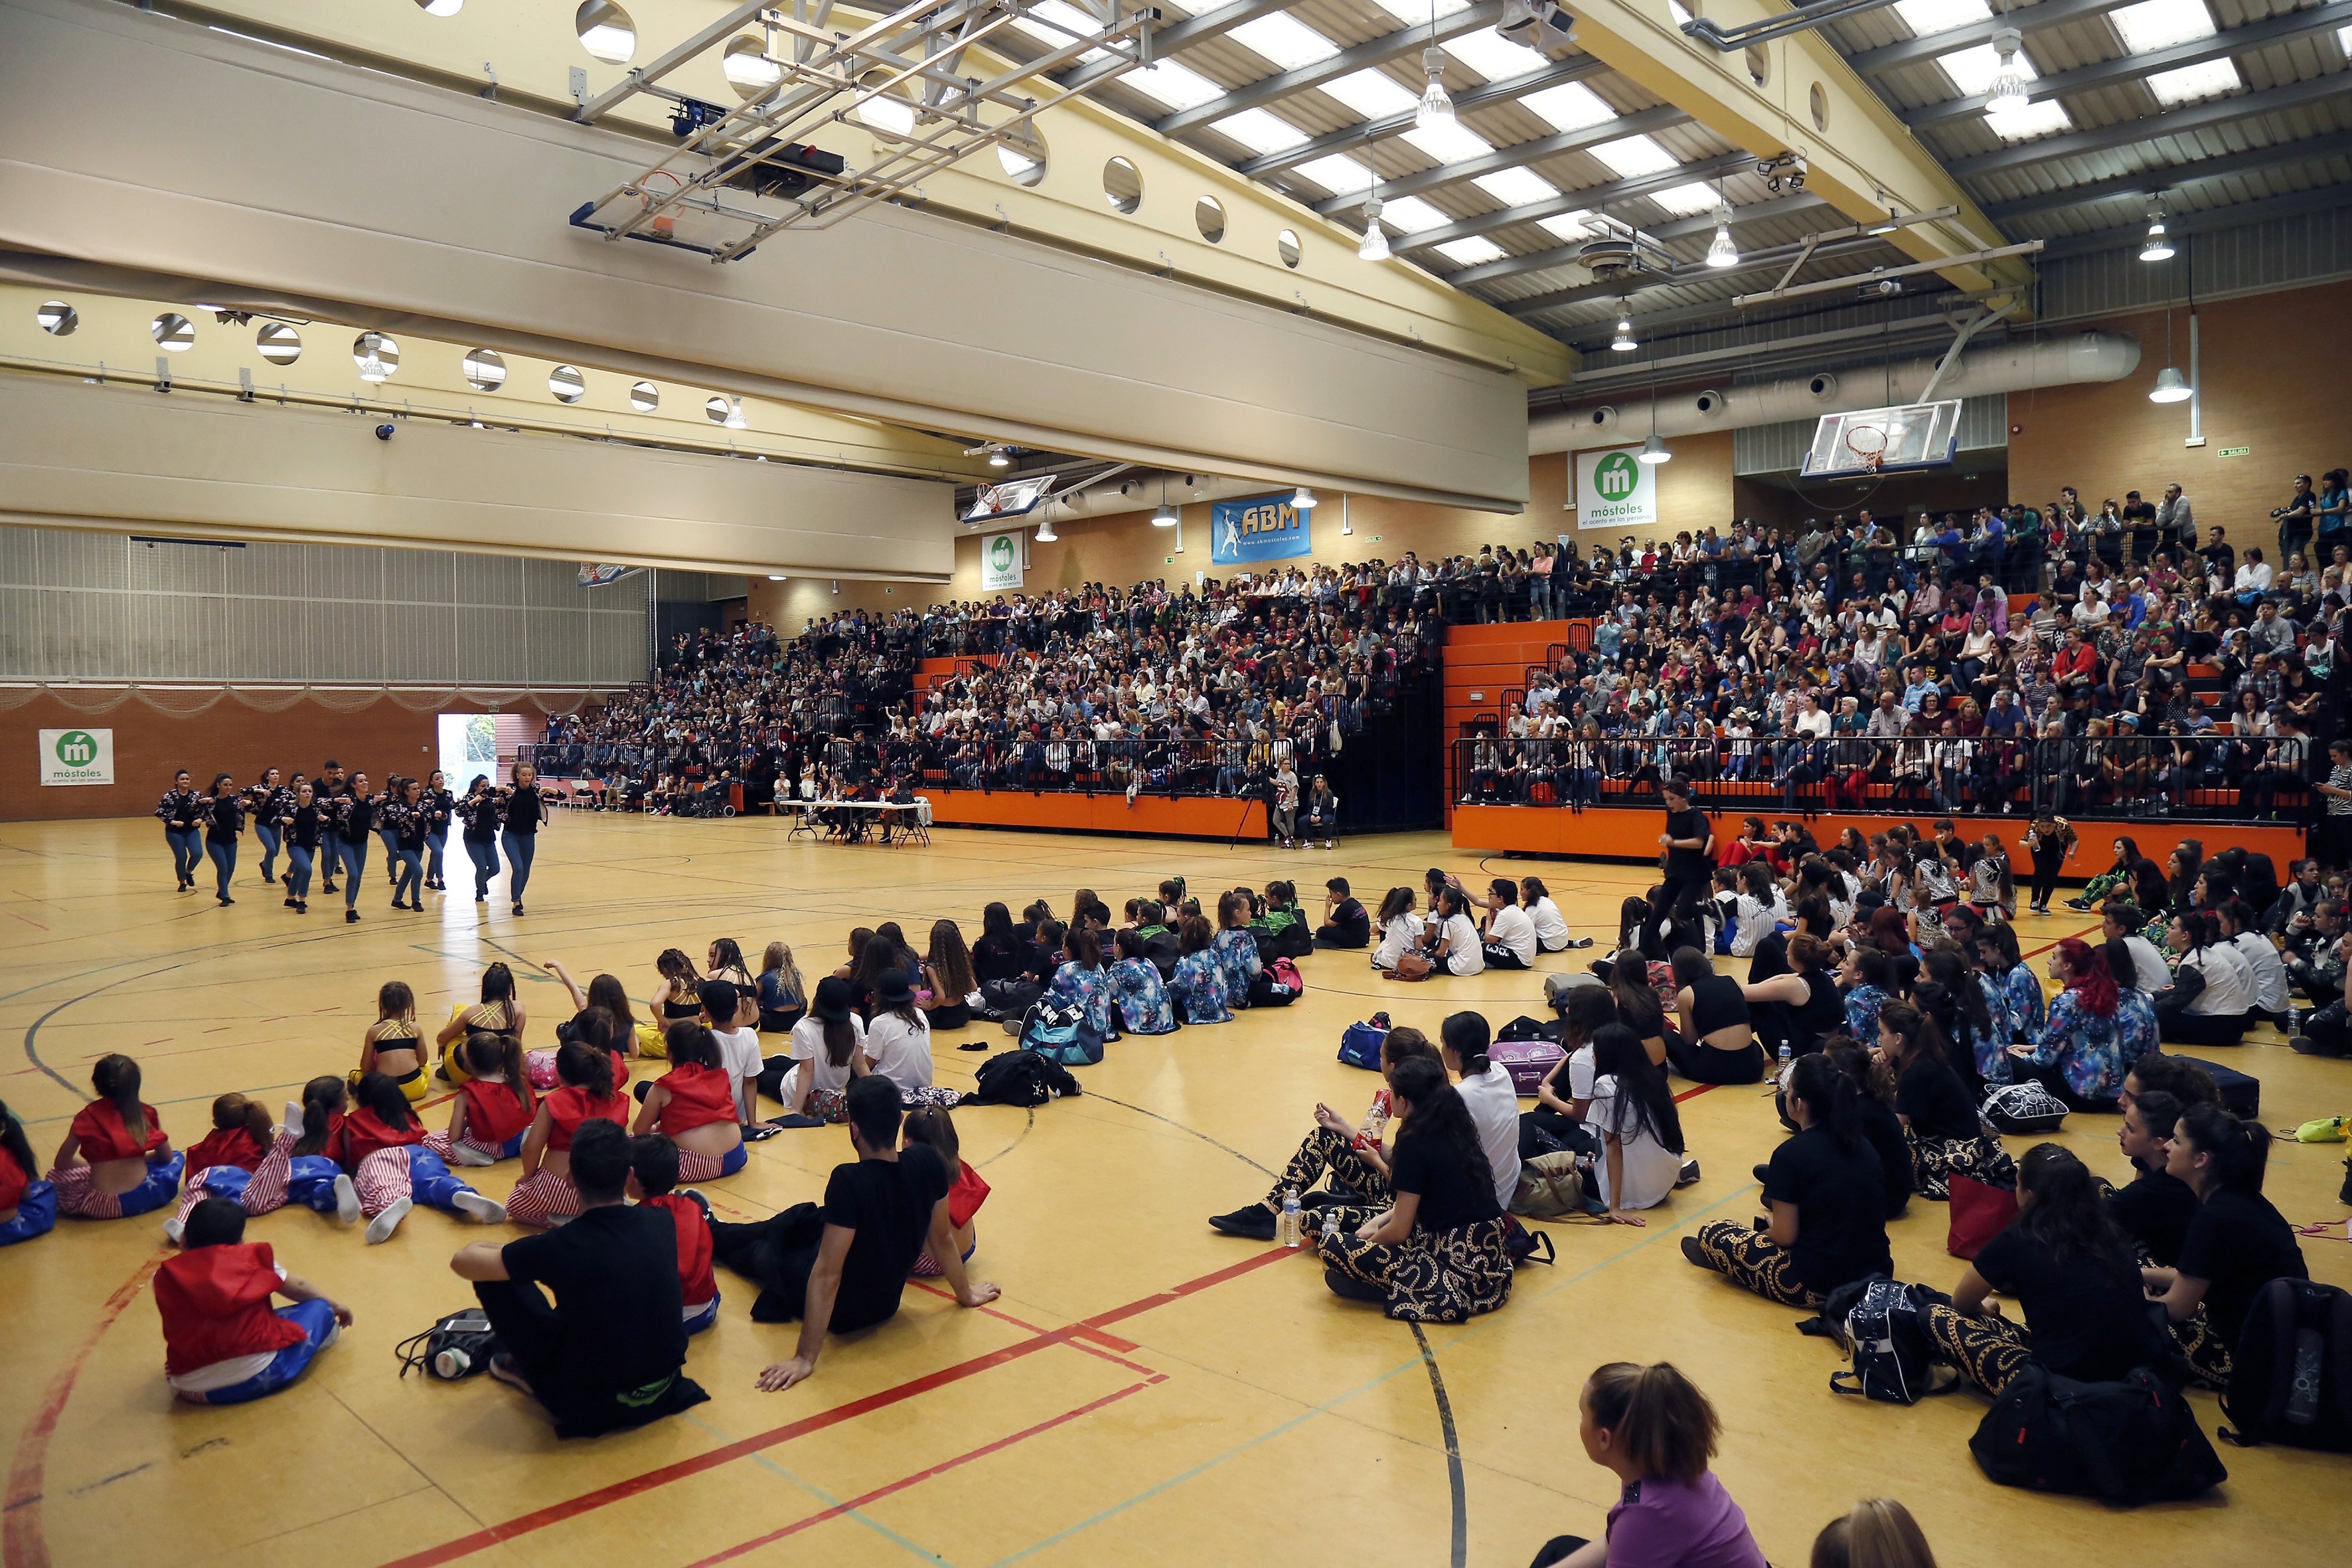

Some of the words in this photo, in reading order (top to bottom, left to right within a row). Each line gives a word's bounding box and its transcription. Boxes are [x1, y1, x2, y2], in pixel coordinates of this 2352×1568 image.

[1591, 503, 1642, 517] móstoles
[1241, 503, 1299, 537] ABM
[1243, 535, 1300, 545] www.abmostoles.com
[989, 573, 1016, 583] móstoles
[53, 769, 102, 777] móstoles
[2010, 1086, 2045, 1099] NEW
[2014, 1093, 2057, 1107] YORK
[2025, 1103, 2057, 1117] CITY
